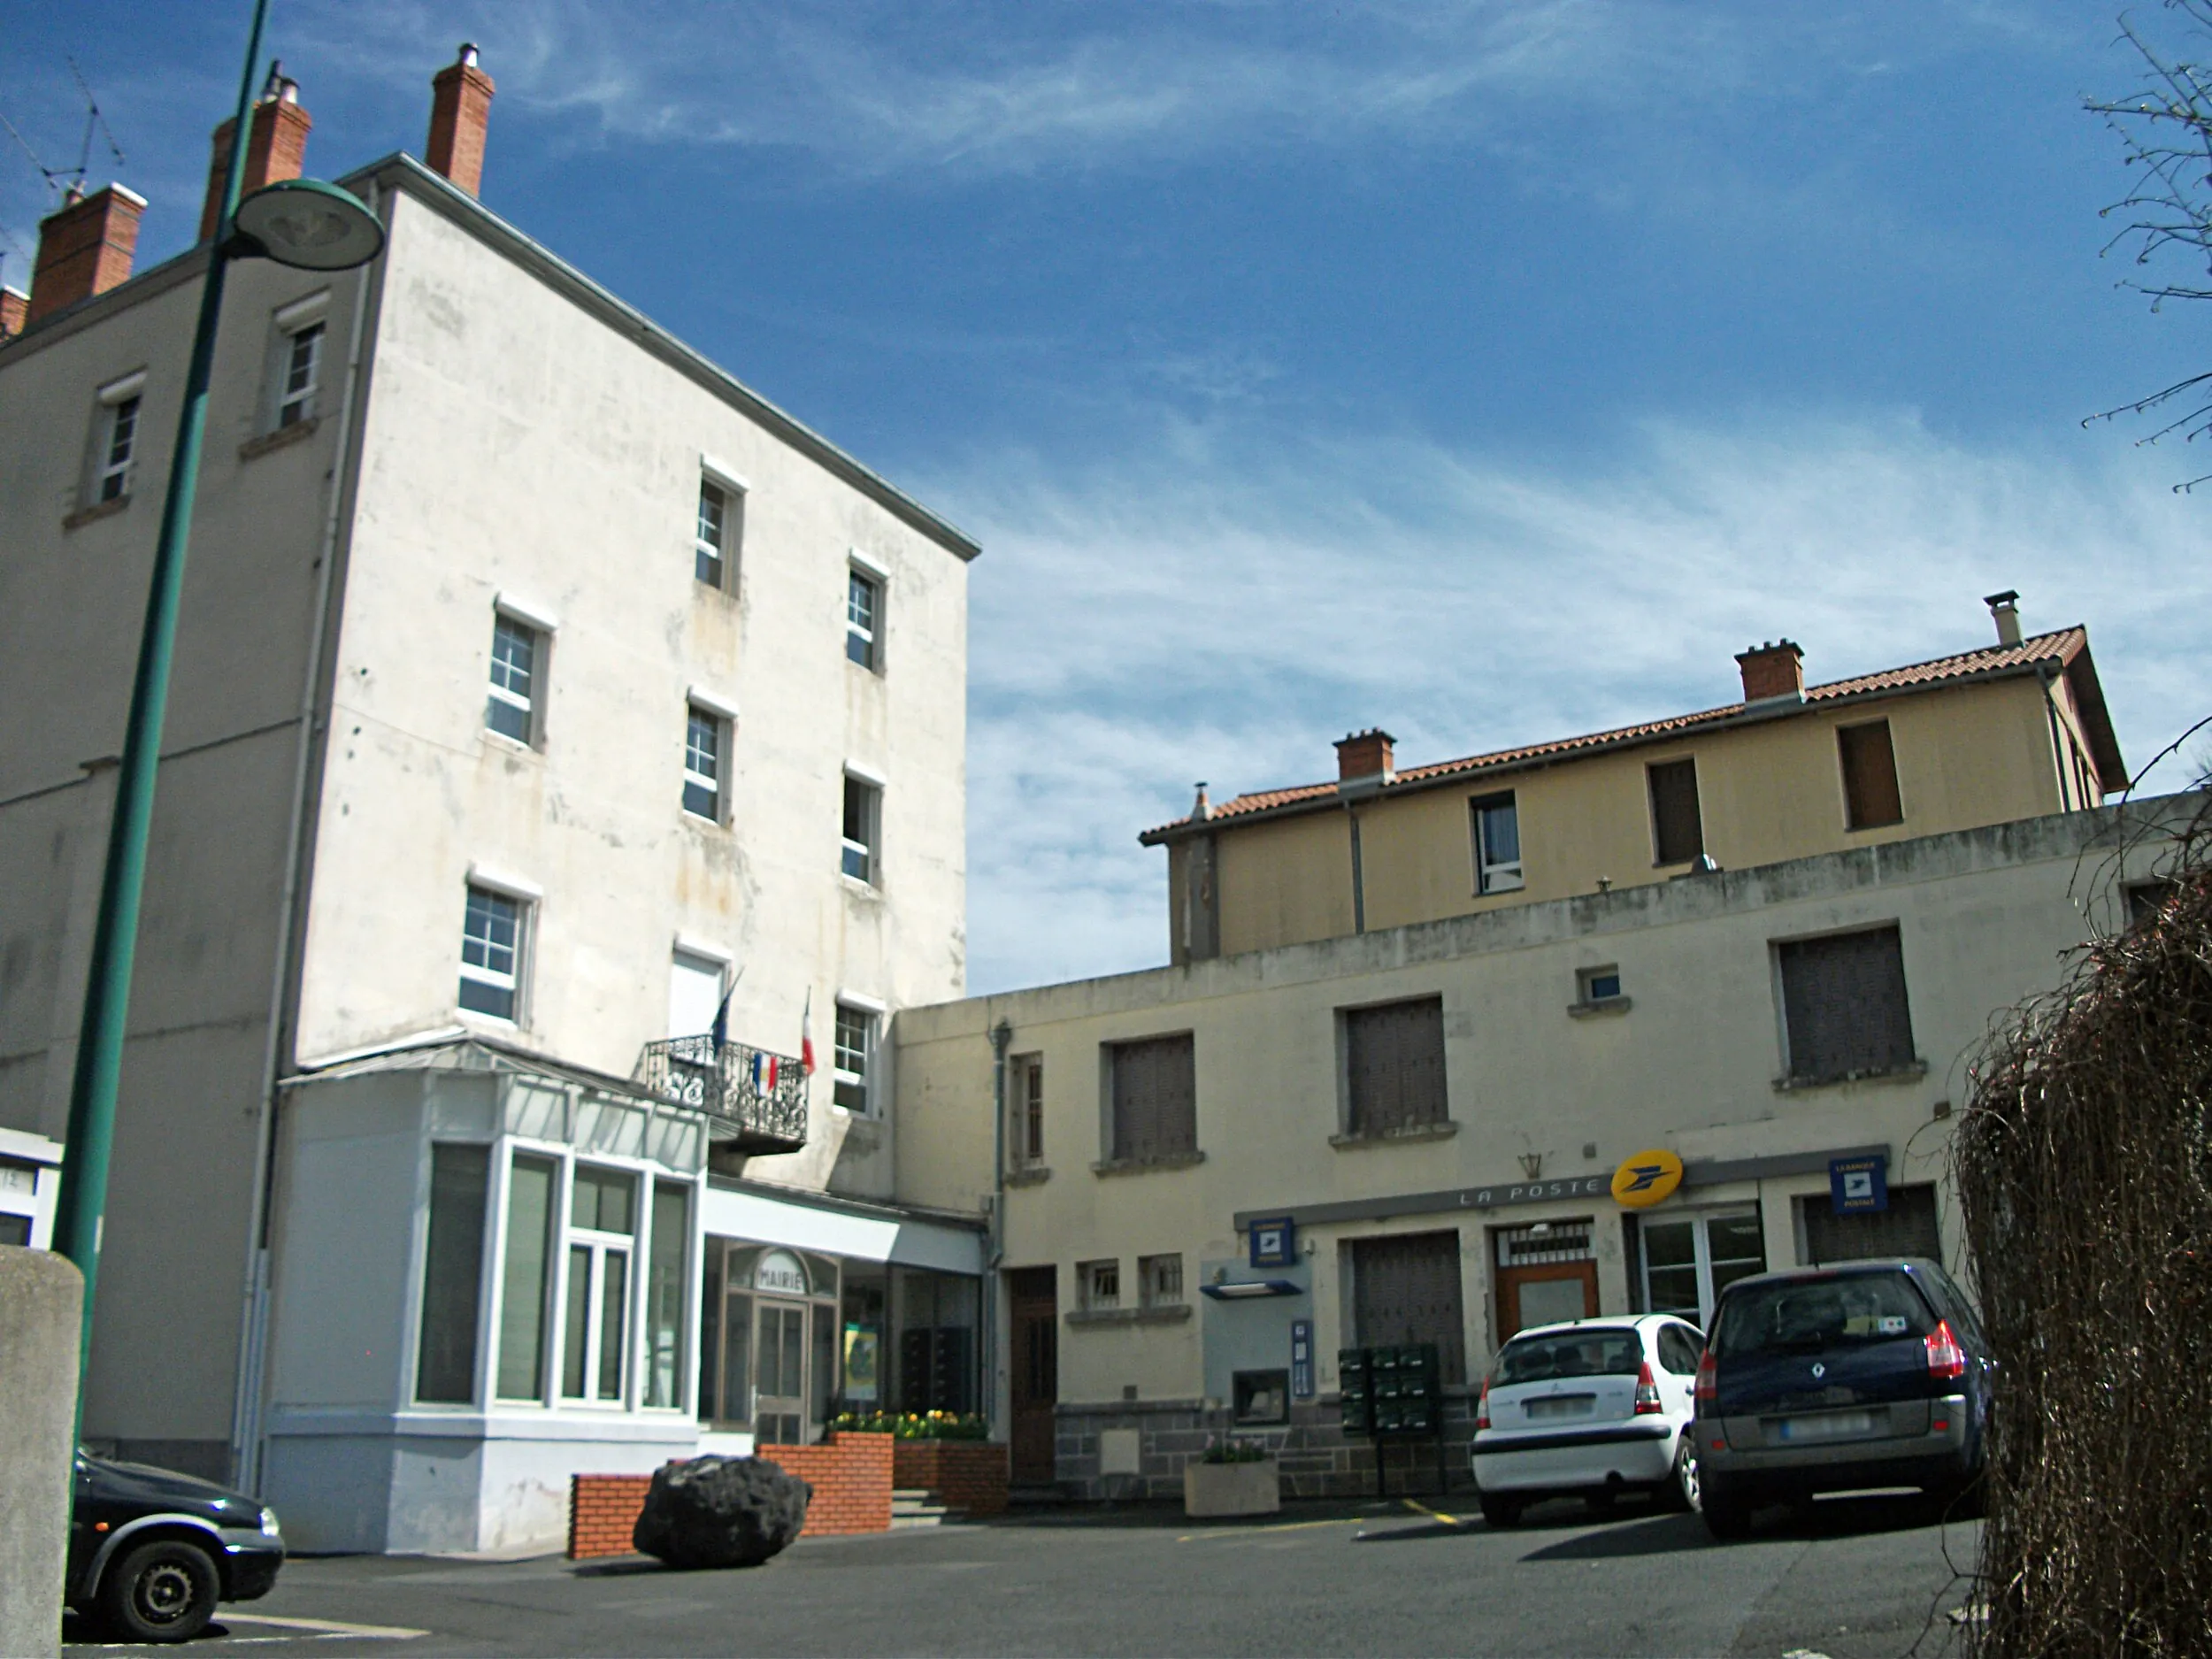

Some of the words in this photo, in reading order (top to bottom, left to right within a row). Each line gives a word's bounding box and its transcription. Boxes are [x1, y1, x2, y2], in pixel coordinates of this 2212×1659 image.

[1460, 1190, 1492, 1205] LA
[1509, 1179, 1600, 1201] POSTE
[759, 1268, 803, 1291] MAIRIE
